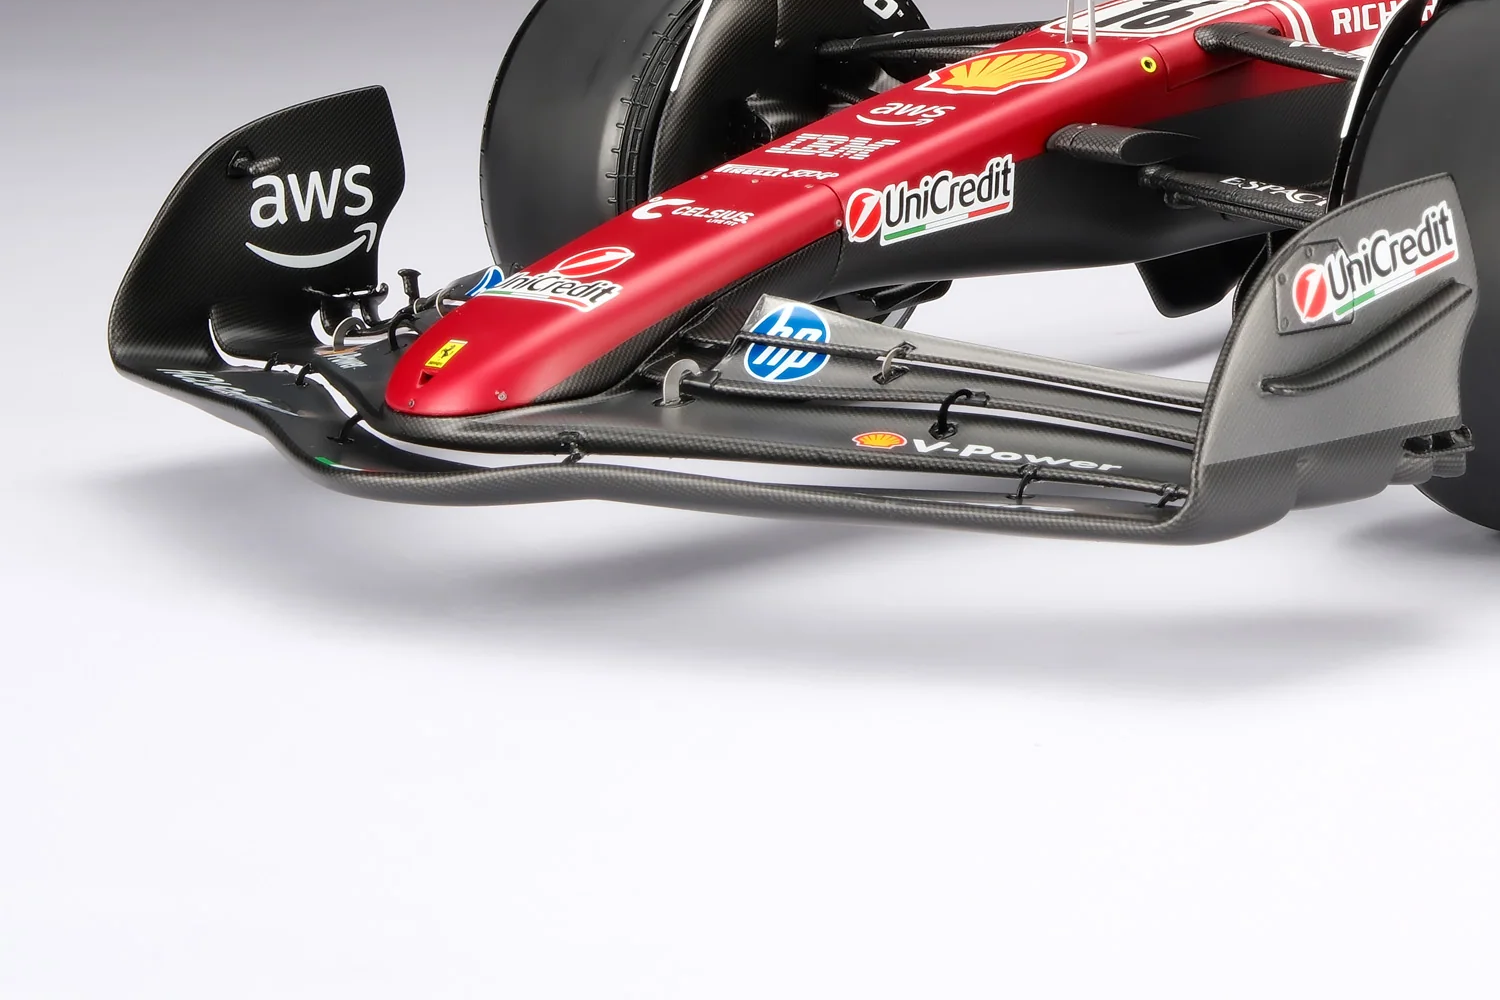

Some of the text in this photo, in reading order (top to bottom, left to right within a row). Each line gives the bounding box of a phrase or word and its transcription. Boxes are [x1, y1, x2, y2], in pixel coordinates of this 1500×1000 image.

[1087, 0, 1223, 30] 16
[870, 102, 956, 118] aws
[765, 133, 900, 160] IBM
[713, 163, 789, 177] PIRELLI
[250, 165, 374, 228] aws
[885, 160, 1012, 227] UniCredit
[671, 206, 755, 224] CELSIUS
[1326, 205, 1453, 300] UniCredit
[498, 272, 617, 305] UniCredit
[753, 303, 824, 381] hp
[913, 439, 1122, 472] V-Power
